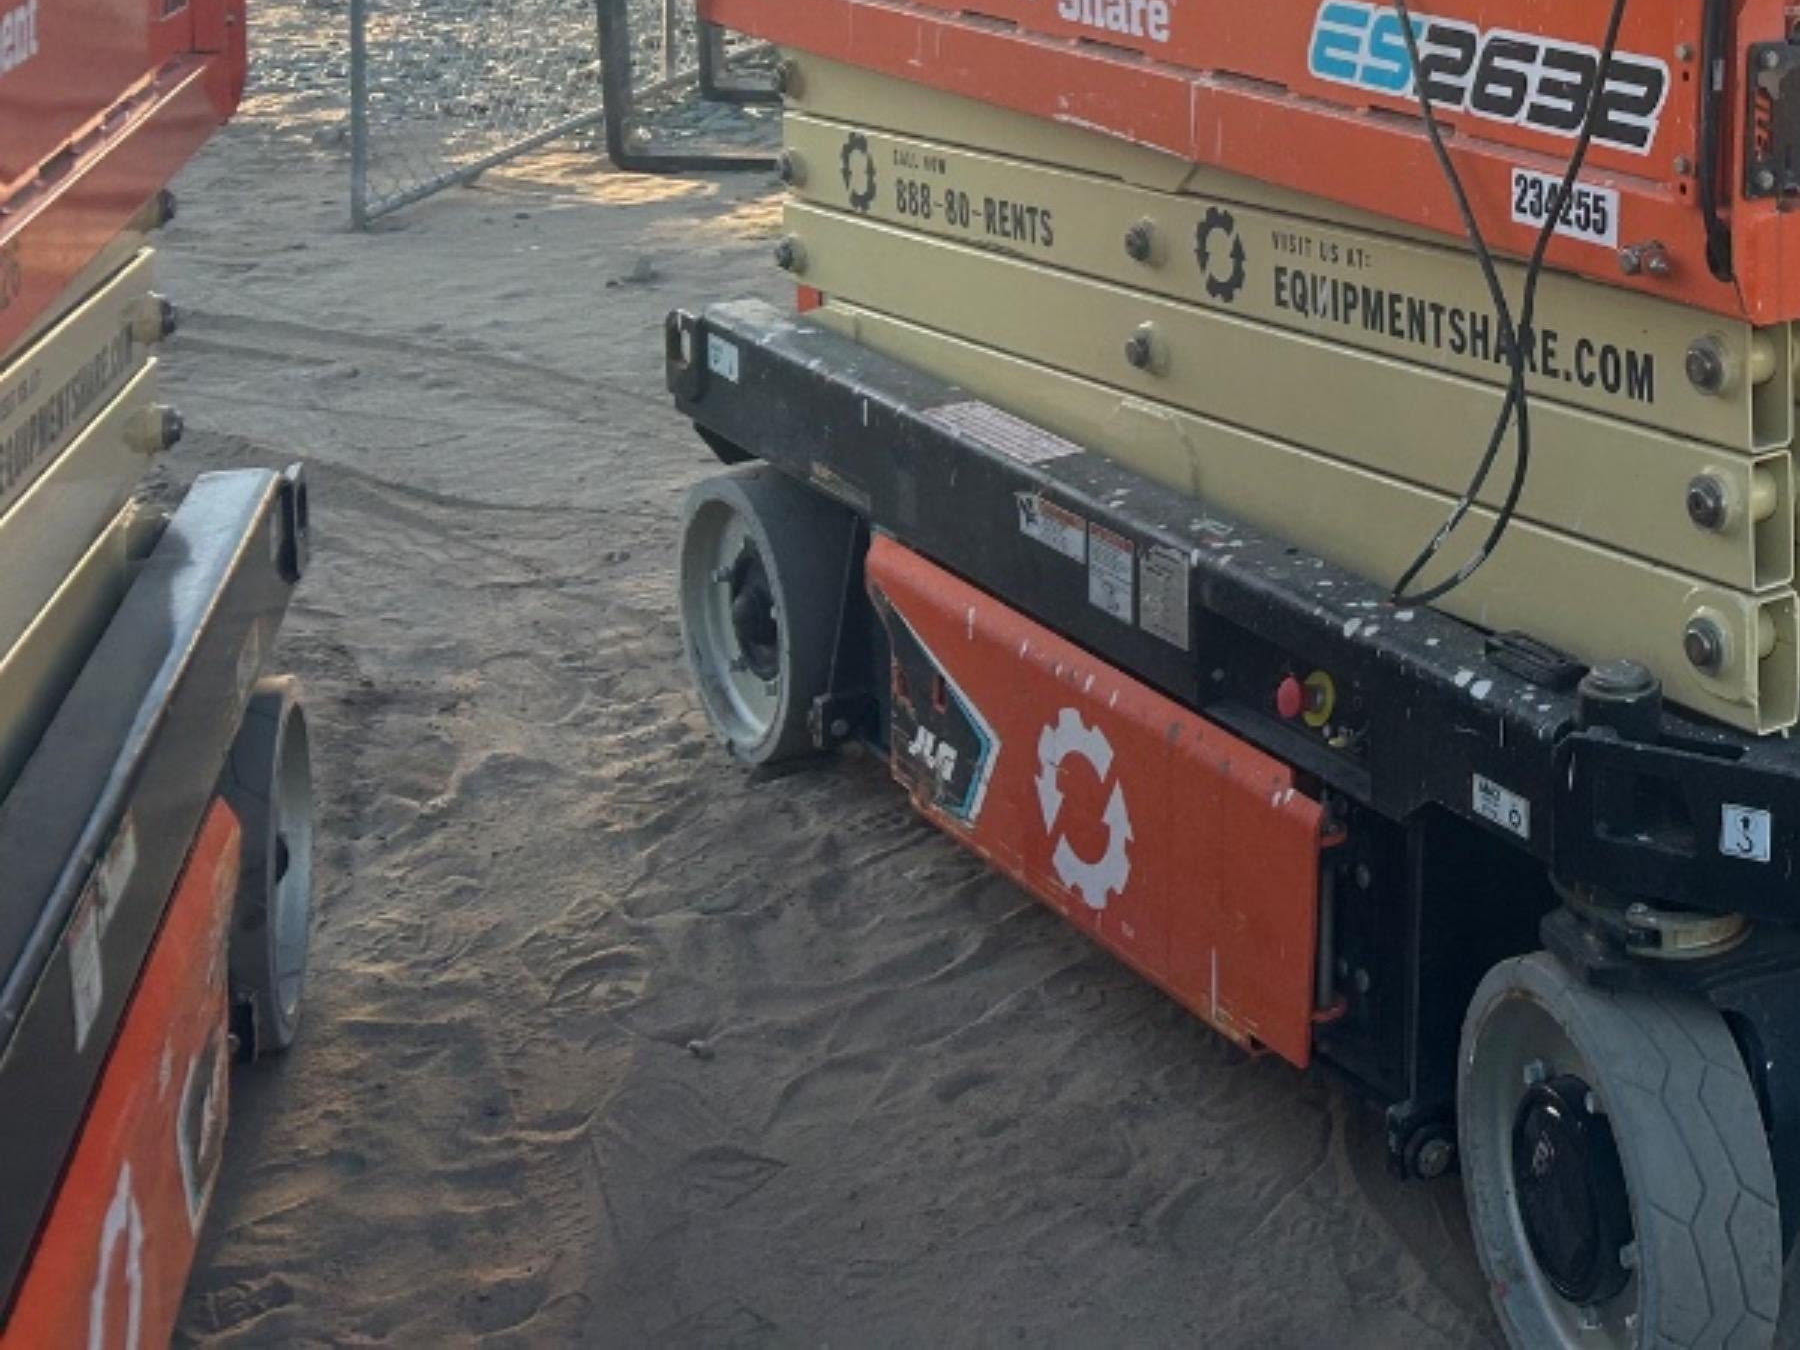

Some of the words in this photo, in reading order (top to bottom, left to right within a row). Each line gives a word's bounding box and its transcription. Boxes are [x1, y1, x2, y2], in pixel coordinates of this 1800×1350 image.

[1312, 0, 1668, 153] ES2632
[896, 179, 1054, 247] 888-80-RENTS
[1514, 173, 1608, 236] 234255
[1272, 230, 1312, 258] VISIT
[1319, 242, 1339, 264] US
